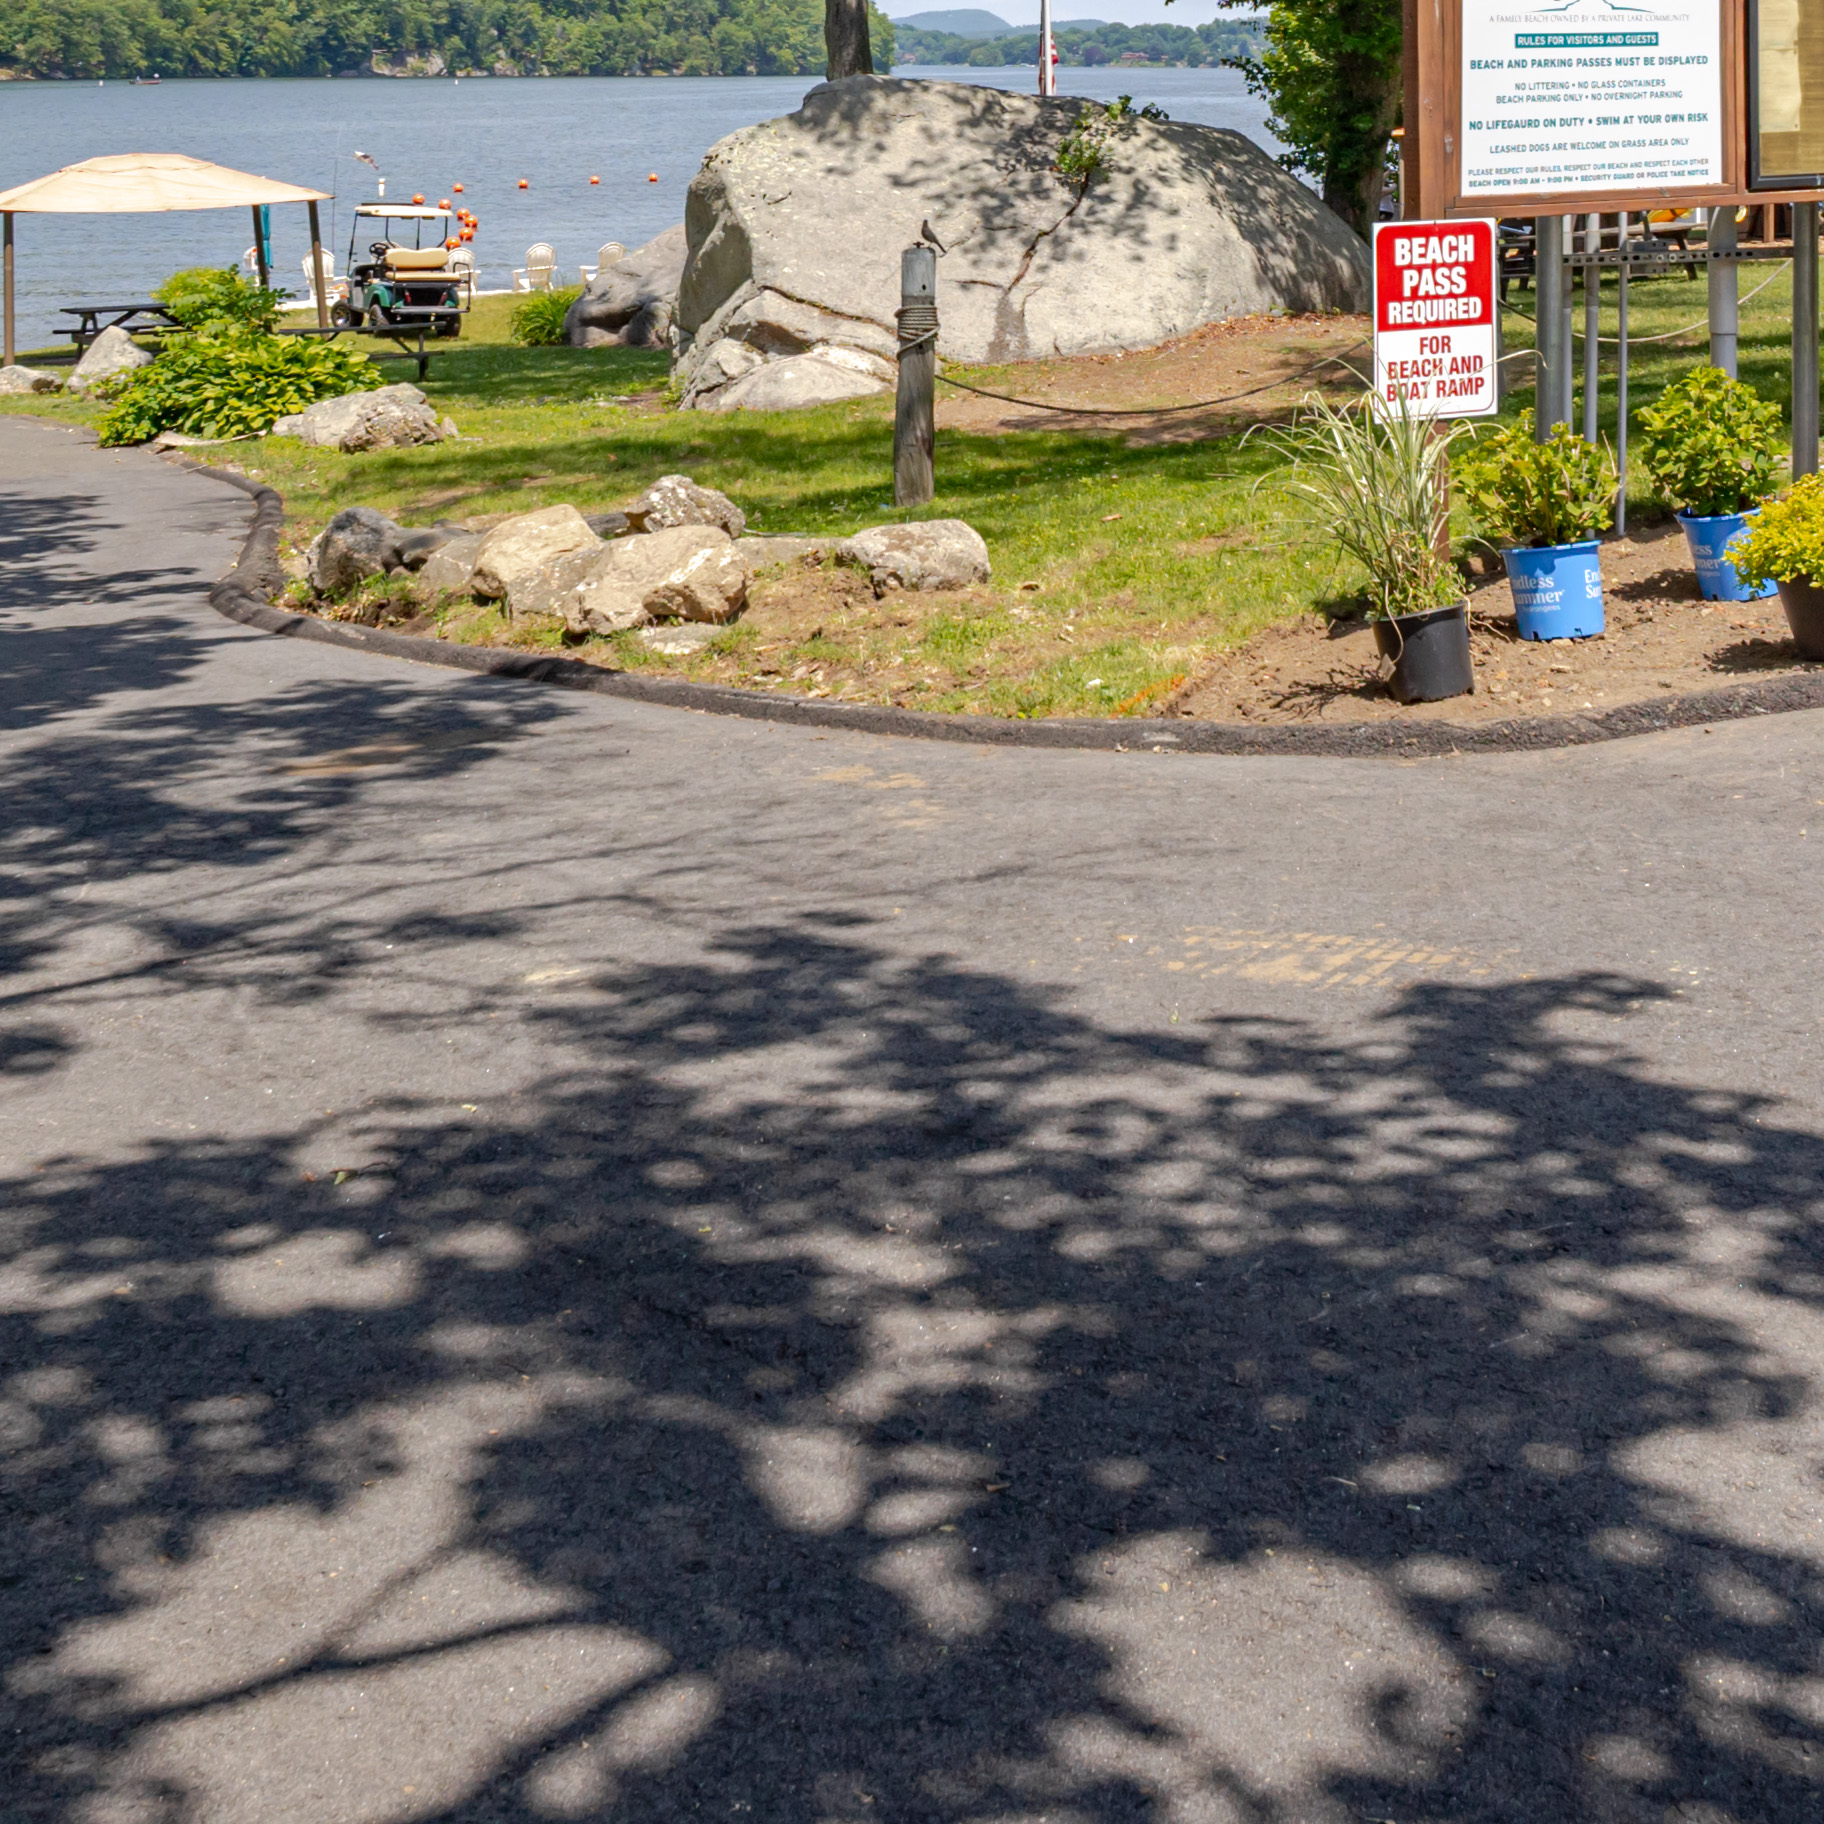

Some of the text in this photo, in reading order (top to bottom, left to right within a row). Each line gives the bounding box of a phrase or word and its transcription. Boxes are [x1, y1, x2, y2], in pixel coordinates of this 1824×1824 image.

[1518, 35, 1656, 45] RULES FOR VISITORS AND GUESTS
[1470, 56, 1708, 69] BEACH AND PARKING PASSES MUST BE DISPLAYED
[1529, 82, 1569, 90] LITTERING
[1618, 79, 1666, 88] CONTAINERS
[1496, 95, 1523, 104] BEACH
[1526, 95, 1561, 103] PARKING
[1564, 94, 1583, 102] ONLY
[1604, 92, 1647, 100] OVERNIGHT
[1650, 91, 1683, 99] PARKING
[1469, 113, 1708, 130] NO LIFEGAURD ON DUTY SWIM AT YOUR OWN RISK
[1490, 145, 1526, 154] LEASHED
[1529, 144, 1549, 152] DOGS
[1552, 143, 1567, 151] ARE
[1570, 142, 1606, 150] WELCOME
[1609, 140, 1619, 148] ON
[1622, 139, 1646, 148] GRASS
[1671, 138, 1689, 146] ONLY
[1468, 168, 1493, 176] PLEASE
[1495, 167, 1523, 175] RESPECT
[1581, 174, 1611, 182] SECURITY
[1394, 234, 1475, 266] BEACH
[1403, 266, 1466, 297] PASS
[1388, 297, 1482, 325] REQUIRED
[1420, 336, 1451, 355] FOR
[1388, 355, 1483, 380] BEACH AND
[1436, 377, 1484, 398] RAMP
[1512, 576, 1554, 589] ndless
[1516, 591, 1562, 604] ummer
